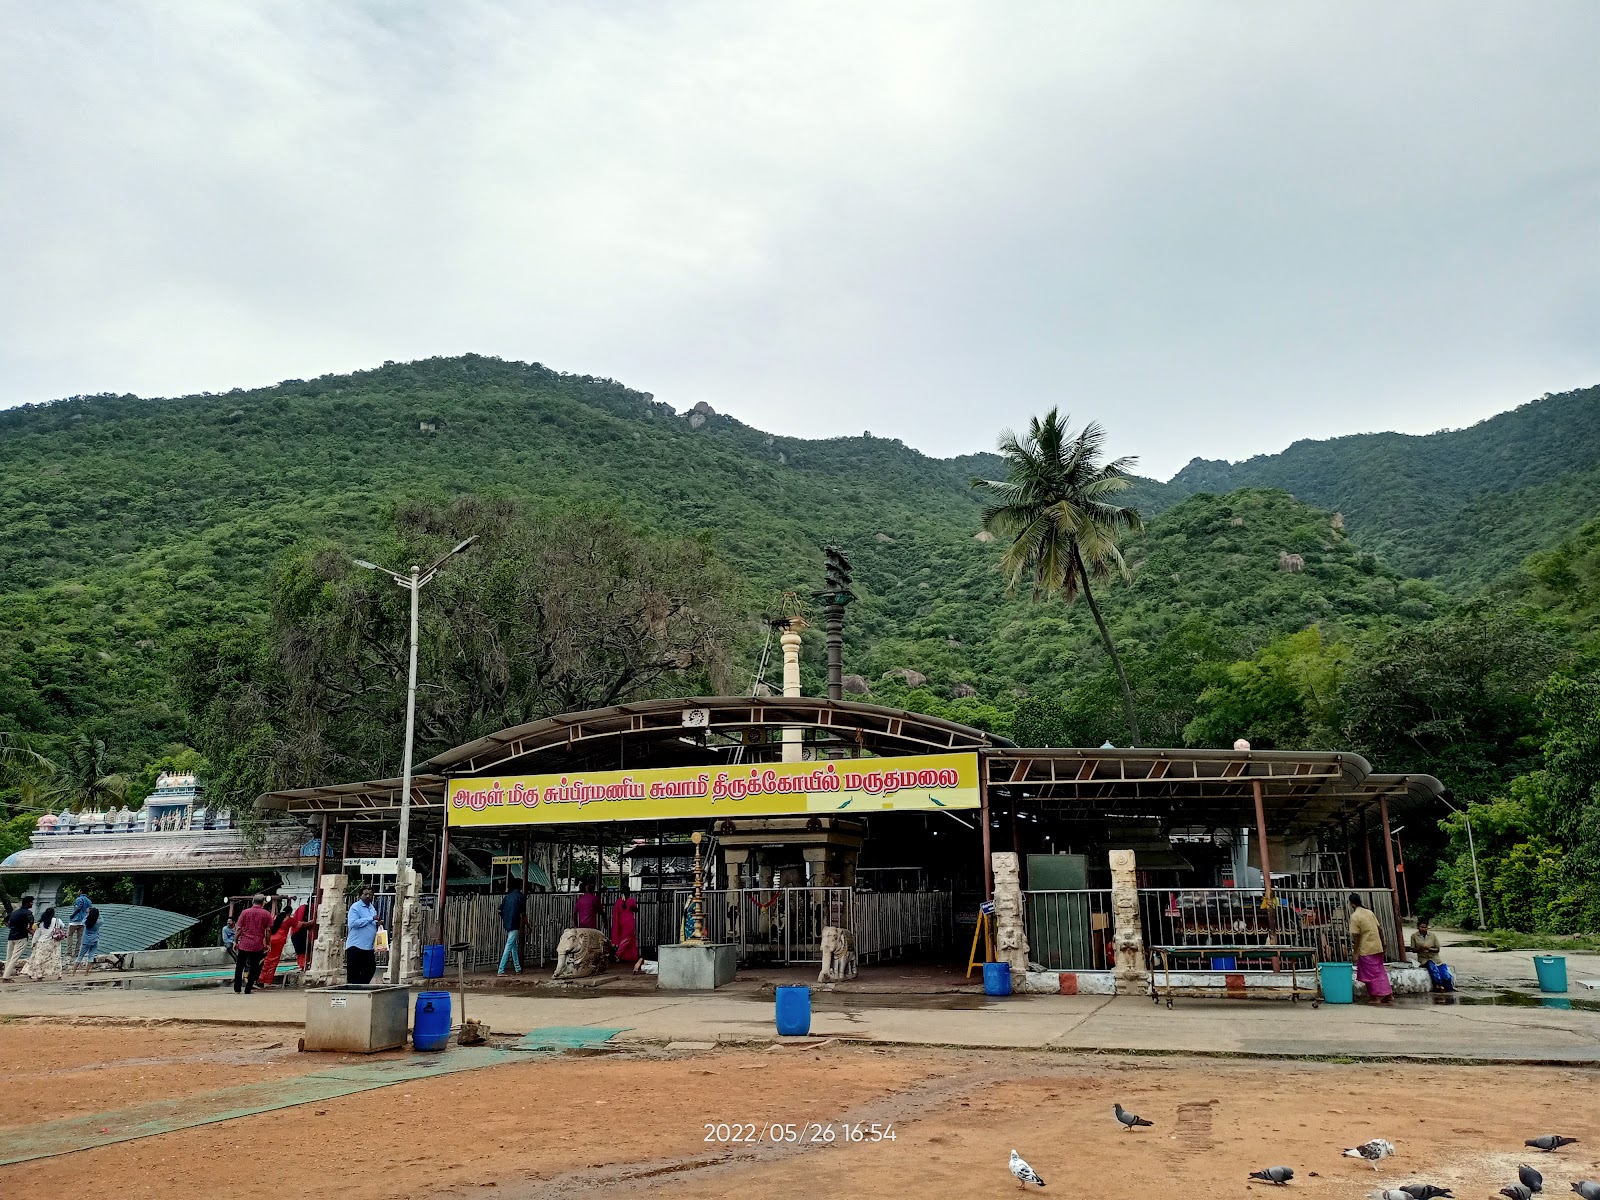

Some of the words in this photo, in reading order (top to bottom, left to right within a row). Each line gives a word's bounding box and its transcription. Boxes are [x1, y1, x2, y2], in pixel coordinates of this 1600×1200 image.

[453, 782, 504, 811] அருள்
[507, 783, 538, 808] மிகு
[543, 777, 646, 809] சுப்பிரமணிய
[650, 774, 709, 799] சுவாமி
[711, 765, 841, 803] திருக்கோயில்
[845, 769, 958, 800] மருதமலை
